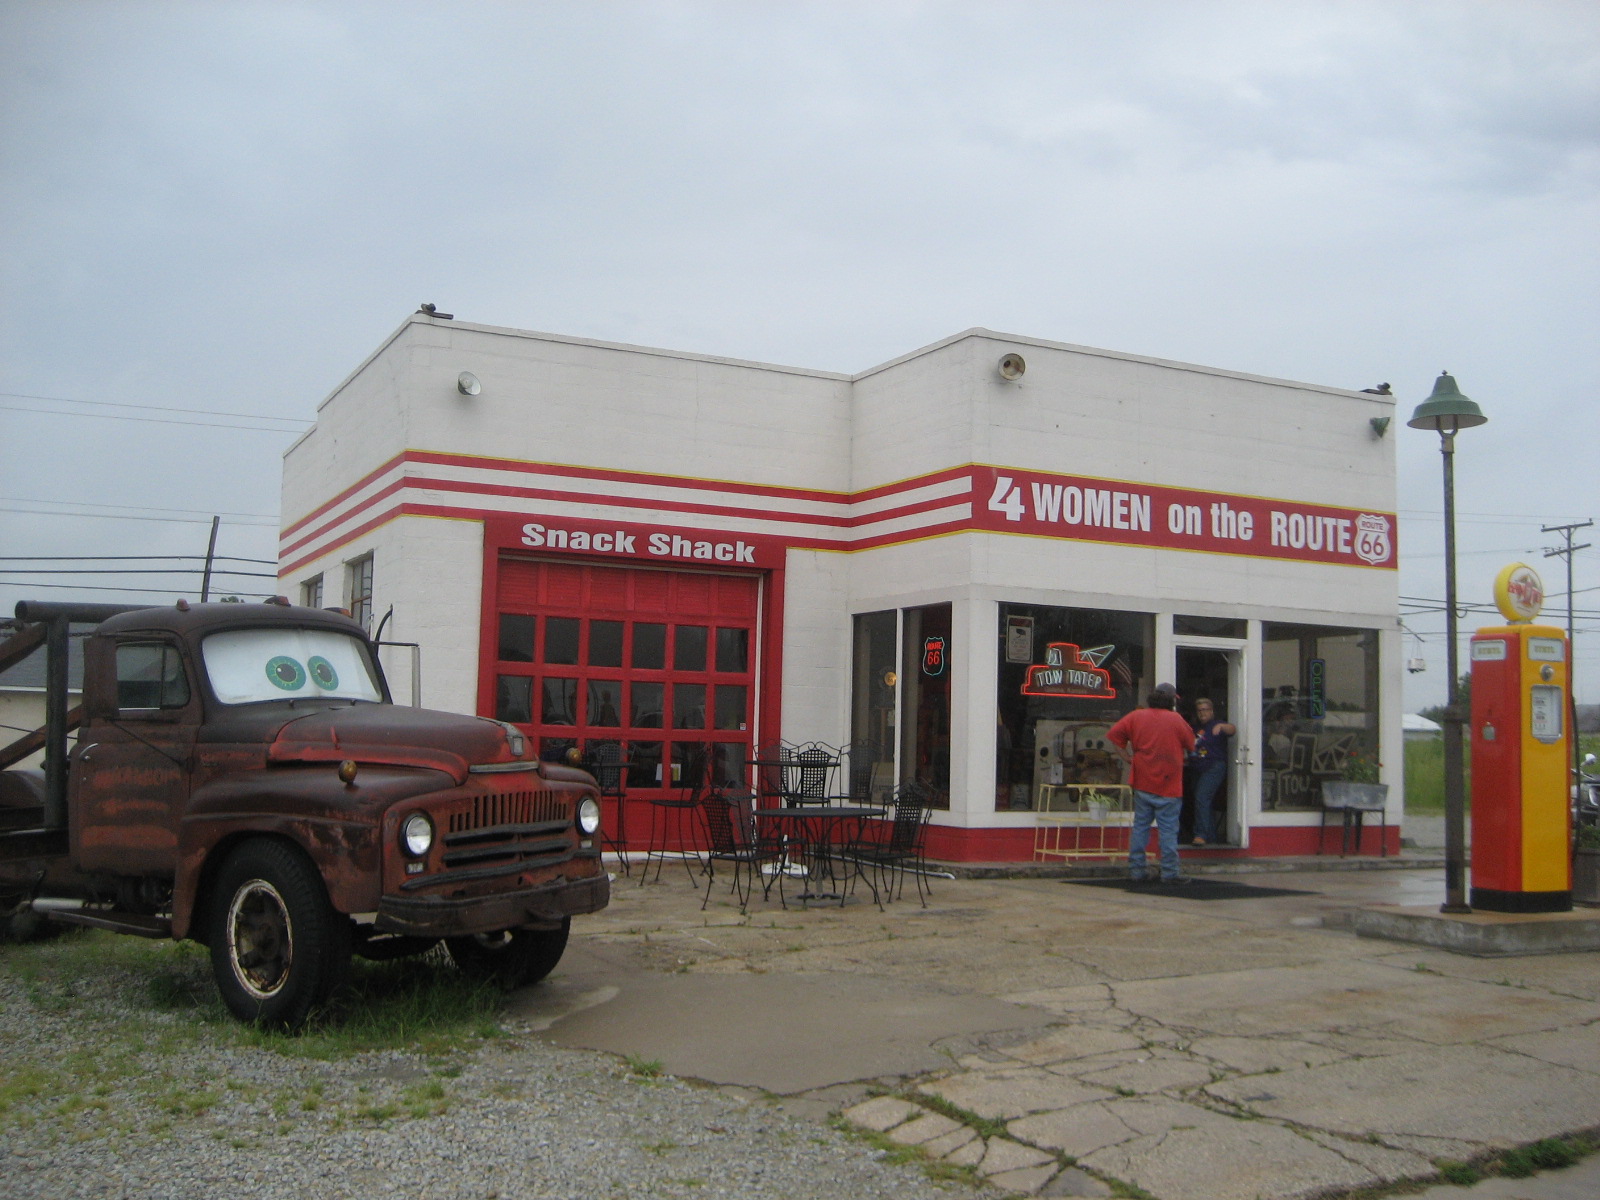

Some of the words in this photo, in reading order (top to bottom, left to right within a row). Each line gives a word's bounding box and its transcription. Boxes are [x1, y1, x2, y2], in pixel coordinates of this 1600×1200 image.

[988, 476, 1025, 521] 4
[1031, 482, 1150, 532] WOMEN
[1167, 503, 1202, 535] on
[1210, 502, 1254, 541] the
[1271, 511, 1352, 553] ROUTE
[1361, 520, 1384, 531] ROUTE
[521, 523, 636, 554] Snack
[648, 533, 756, 563] Shack
[1361, 533, 1384, 556] 66
[927, 651, 940, 665] 66
[1036, 669, 1063, 687] TOW
[1312, 662, 1322, 716] OPEN
